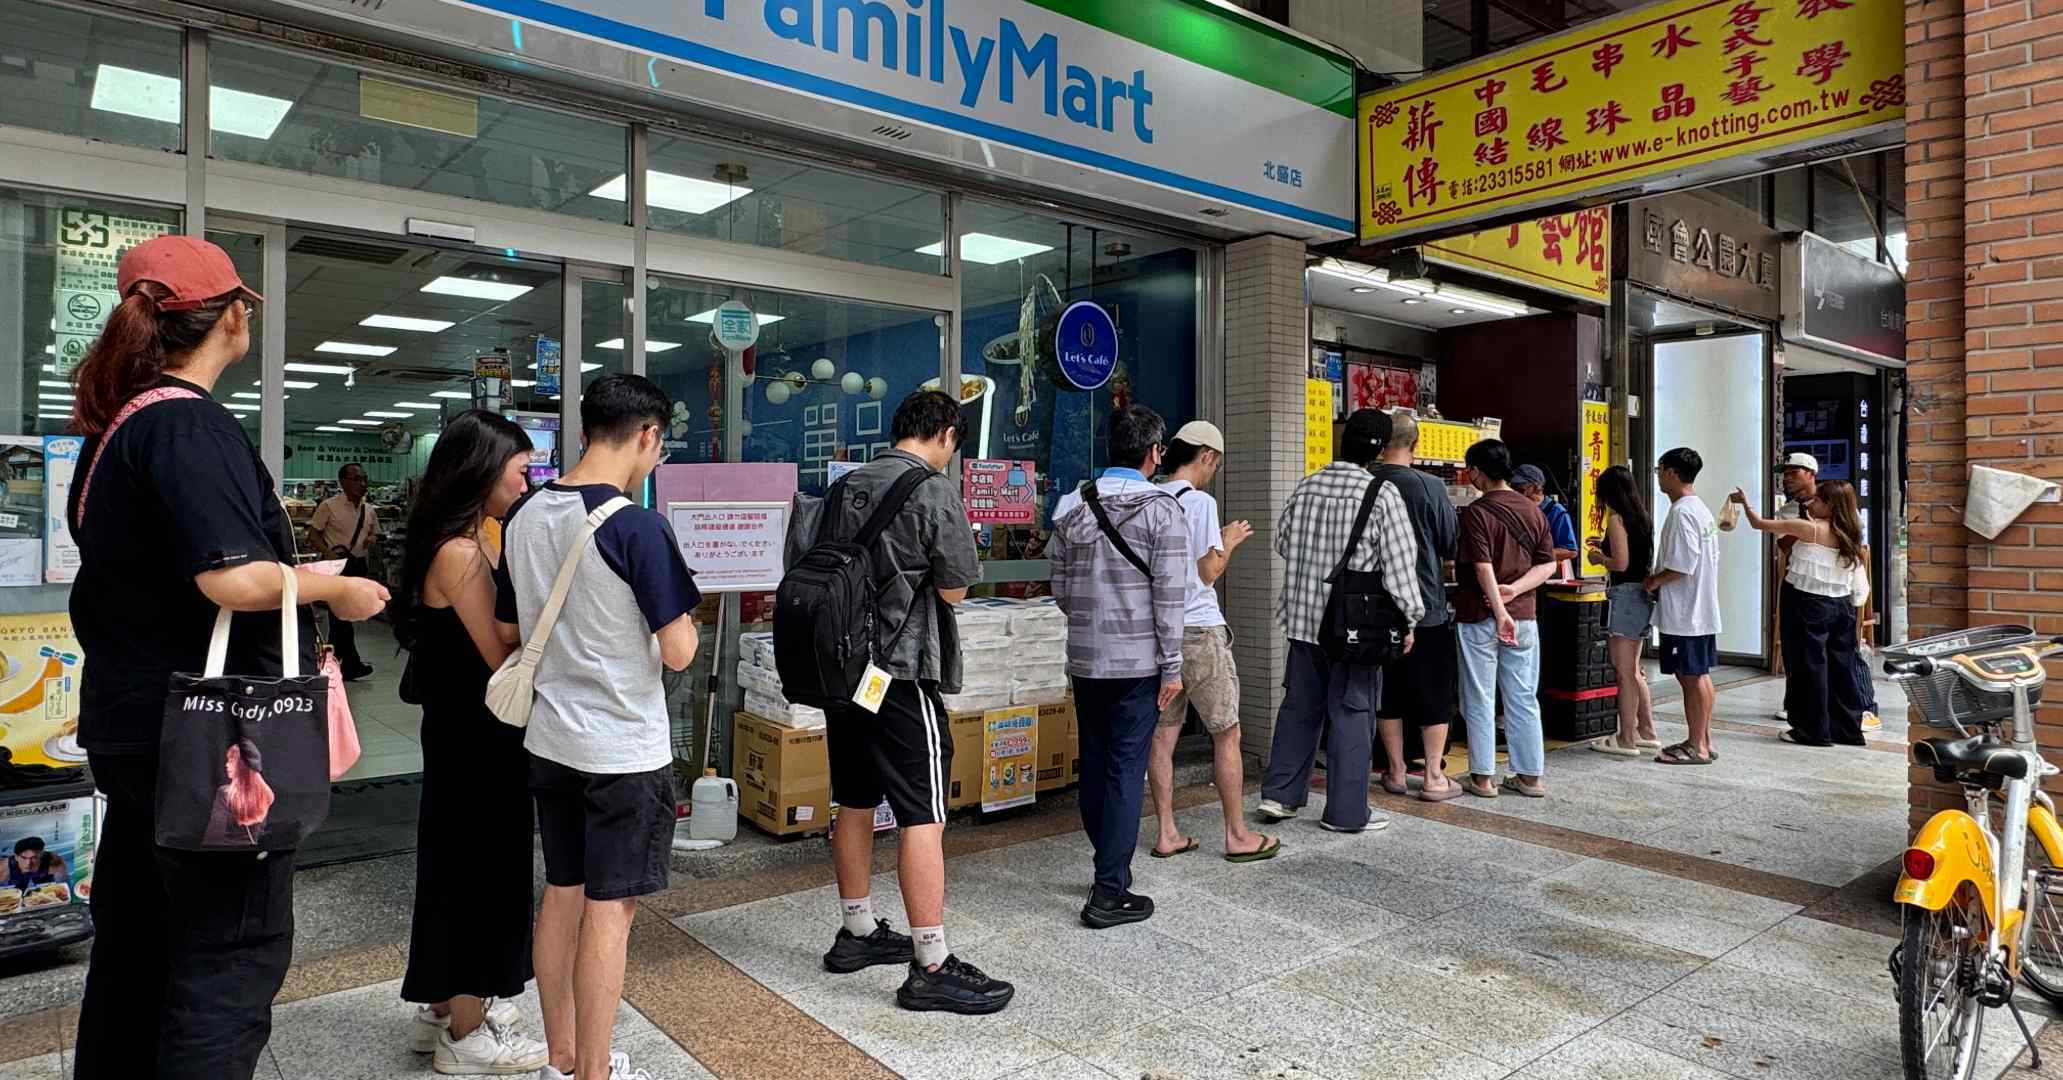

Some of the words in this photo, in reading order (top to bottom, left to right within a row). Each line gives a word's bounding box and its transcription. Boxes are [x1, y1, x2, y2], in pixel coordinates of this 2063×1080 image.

[703, 0, 1154, 145] amilyMart
[1525, 61, 1569, 151] 毛線
[1585, 43, 1632, 136] 串珠
[1651, 24, 1701, 122] 水晶
[1473, 79, 1509, 167] 中國結
[1065, 351, 1086, 364] Let's
[183, 696, 224, 712] Miss
